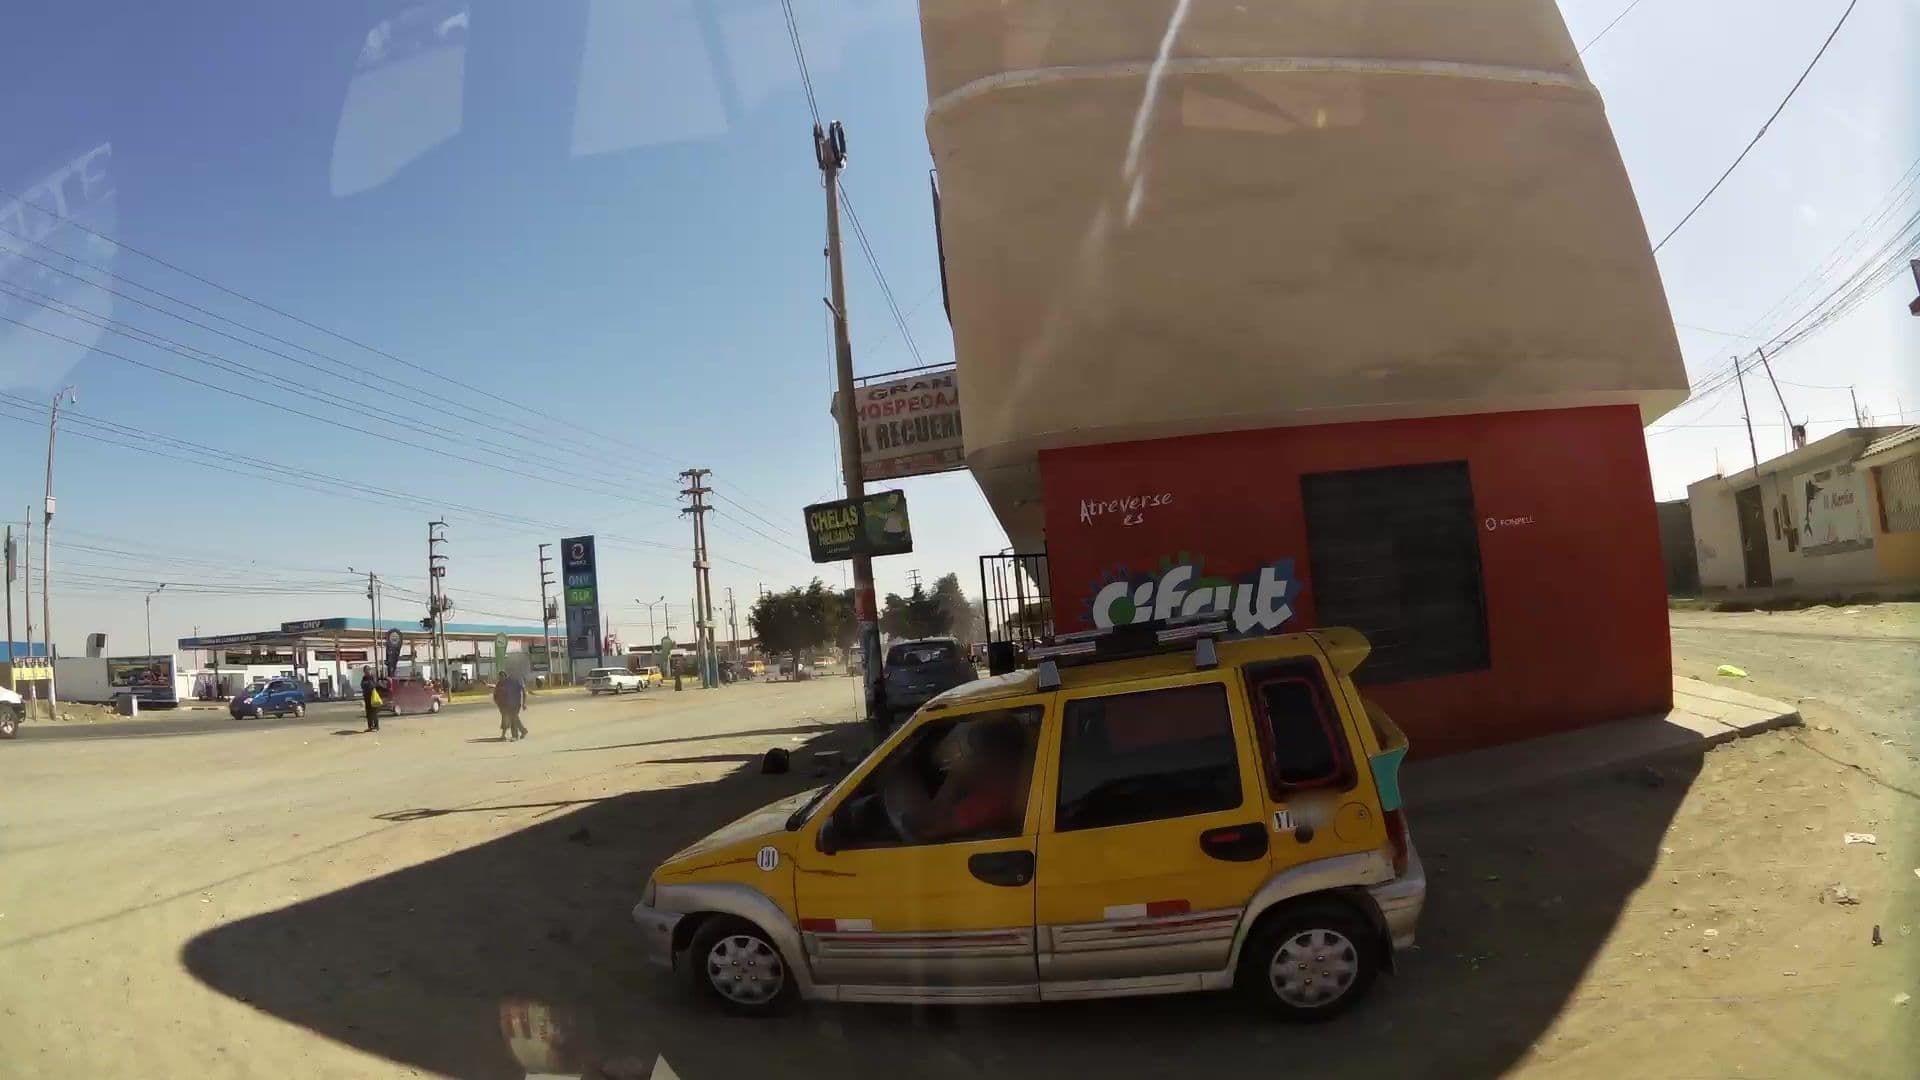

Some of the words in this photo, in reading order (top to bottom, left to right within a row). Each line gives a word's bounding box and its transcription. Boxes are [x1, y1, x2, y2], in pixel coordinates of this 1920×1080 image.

[868, 375, 953, 400] GRAN
[810, 503, 859, 533] CHELAS
[1080, 492, 1174, 527] Atreverse
[1123, 512, 1145, 526] es
